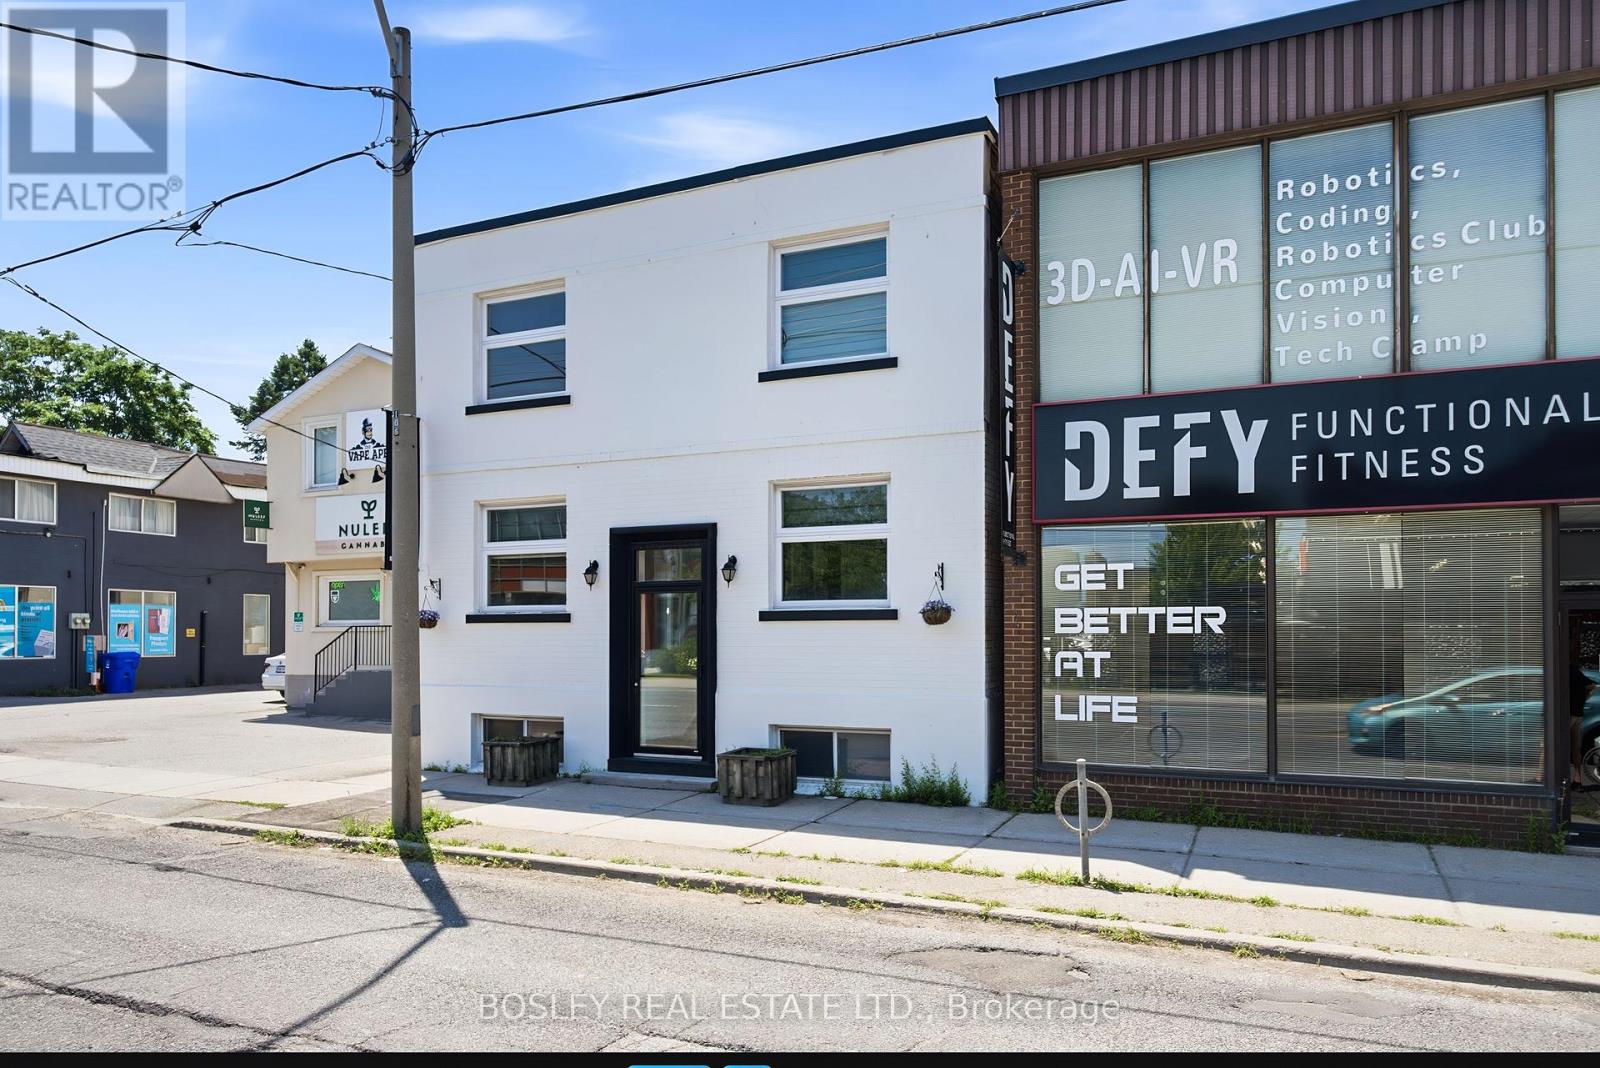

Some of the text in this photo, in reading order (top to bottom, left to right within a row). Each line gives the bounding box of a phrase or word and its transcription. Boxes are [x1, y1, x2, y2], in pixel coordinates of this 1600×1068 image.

[1461, 214, 1546, 245] Club
[1275, 340, 1353, 368] Tech
[1291, 391, 1600, 441] FUNCTIONAL
[348, 449, 370, 462] VAPE
[1064, 409, 1269, 502] DEFY
[1291, 444, 1485, 483] FITNESS
[341, 540, 385, 550] CANNAB
[1054, 562, 1135, 591] GET
[1054, 606, 1227, 634] BETTER
[1054, 651, 1111, 678] AT
[1054, 694, 1138, 723] LIFE
